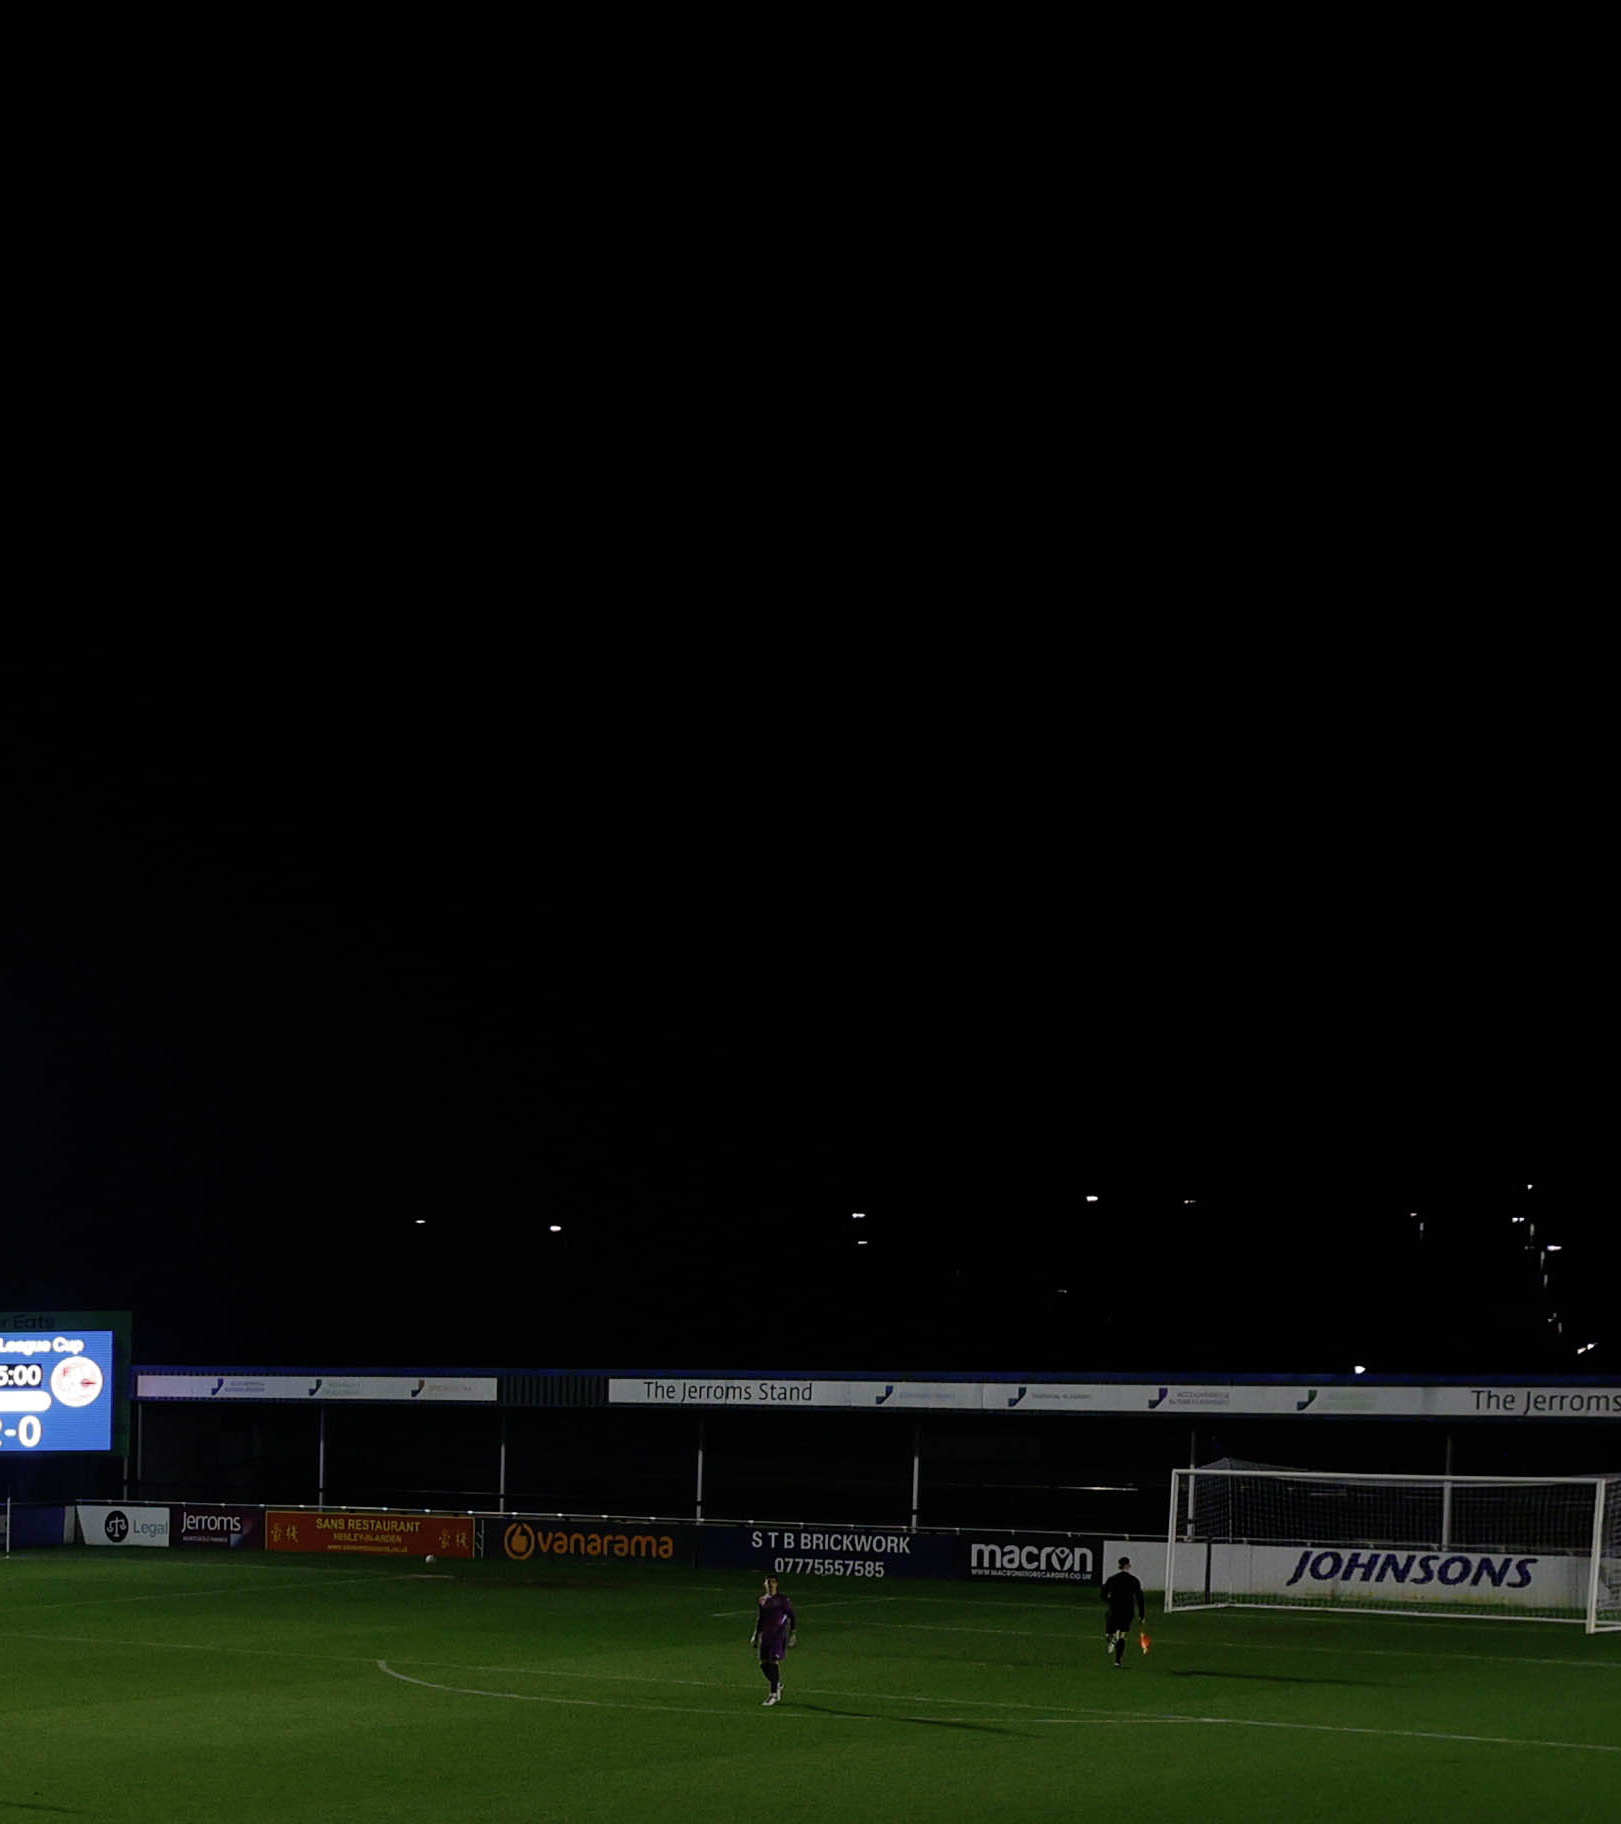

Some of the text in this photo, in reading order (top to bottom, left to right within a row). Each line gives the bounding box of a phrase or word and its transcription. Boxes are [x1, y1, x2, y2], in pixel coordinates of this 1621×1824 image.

[52, 1336, 85, 1354] Cup
[643, 1381, 813, 1402] The Jerroms Stand
[1471, 1389, 1621, 1415] The Jerroms
[133, 1519, 169, 1538] Legal
[181, 1511, 242, 1533] Jerroms
[315, 1518, 422, 1532] SANS RESTAURANT
[537, 1531, 675, 1560] vanarama
[751, 1530, 912, 1554] S T B BRICKWORK
[774, 1557, 885, 1578] 07775557585
[970, 1543, 1094, 1572] macron
[1286, 1550, 1539, 1588] JOHNSONS
